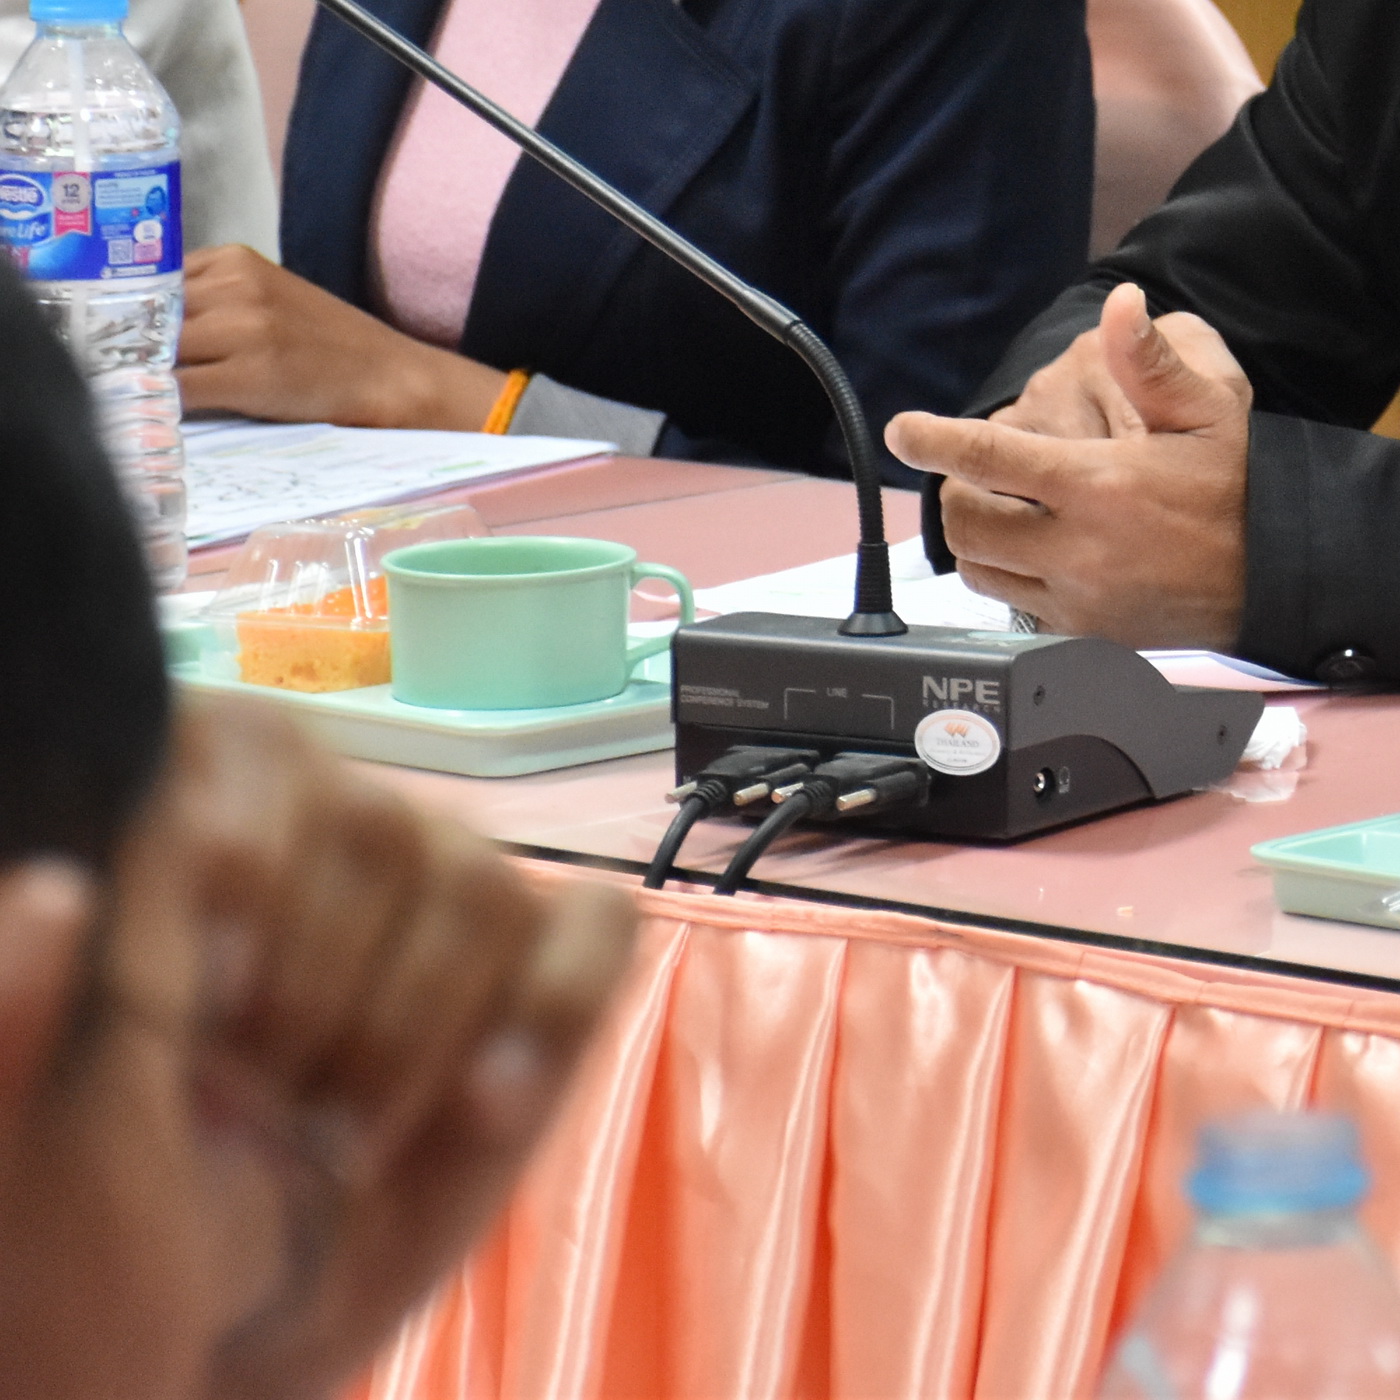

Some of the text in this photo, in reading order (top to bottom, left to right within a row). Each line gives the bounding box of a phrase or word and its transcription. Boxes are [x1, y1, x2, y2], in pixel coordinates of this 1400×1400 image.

[62, 183, 80, 198] 12
[17, 221, 45, 241] Life
[826, 687, 848, 698] LINE
[922, 675, 1000, 705] NPE
